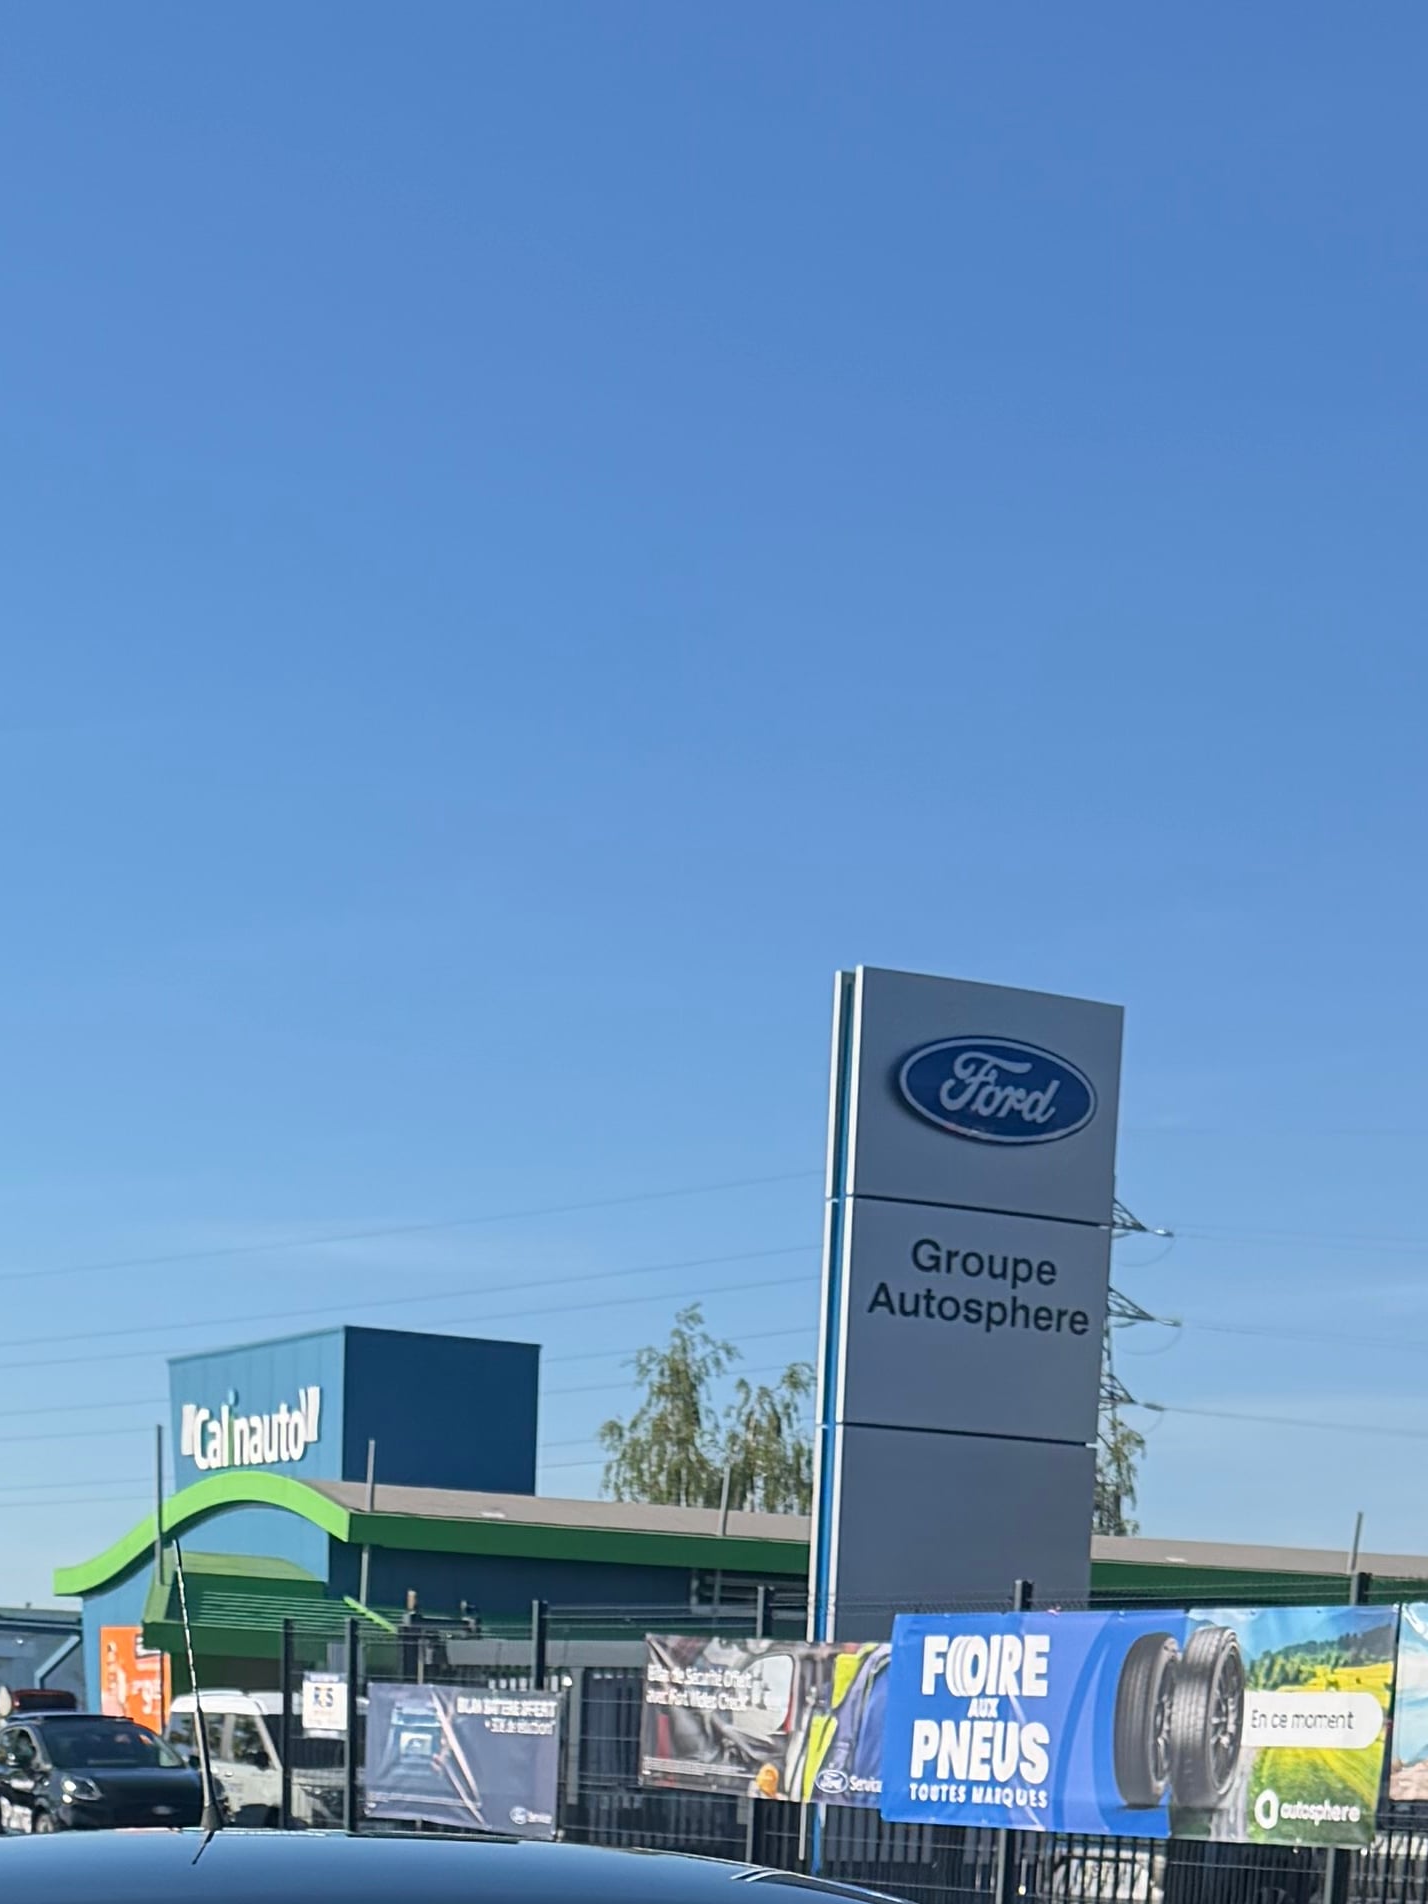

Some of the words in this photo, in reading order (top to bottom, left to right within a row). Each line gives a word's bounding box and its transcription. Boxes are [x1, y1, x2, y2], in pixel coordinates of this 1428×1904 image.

[940, 1050, 1061, 1124] Ford
[911, 1238, 1057, 1289] Groupe
[867, 1282, 1090, 1336] Autosphere
[922, 1634, 1051, 1697] FOIRE
[967, 1698, 1000, 1718] AUX
[1251, 1709, 1268, 1729] En
[1271, 1711, 1288, 1729] ce
[1291, 1710, 1355, 1730] moment
[910, 1719, 1051, 1785] PNEUS
[909, 1783, 967, 1803] TOUTES
[971, 1786, 1049, 1808] MARQUES
[1280, 1798, 1361, 1826] autosphere
